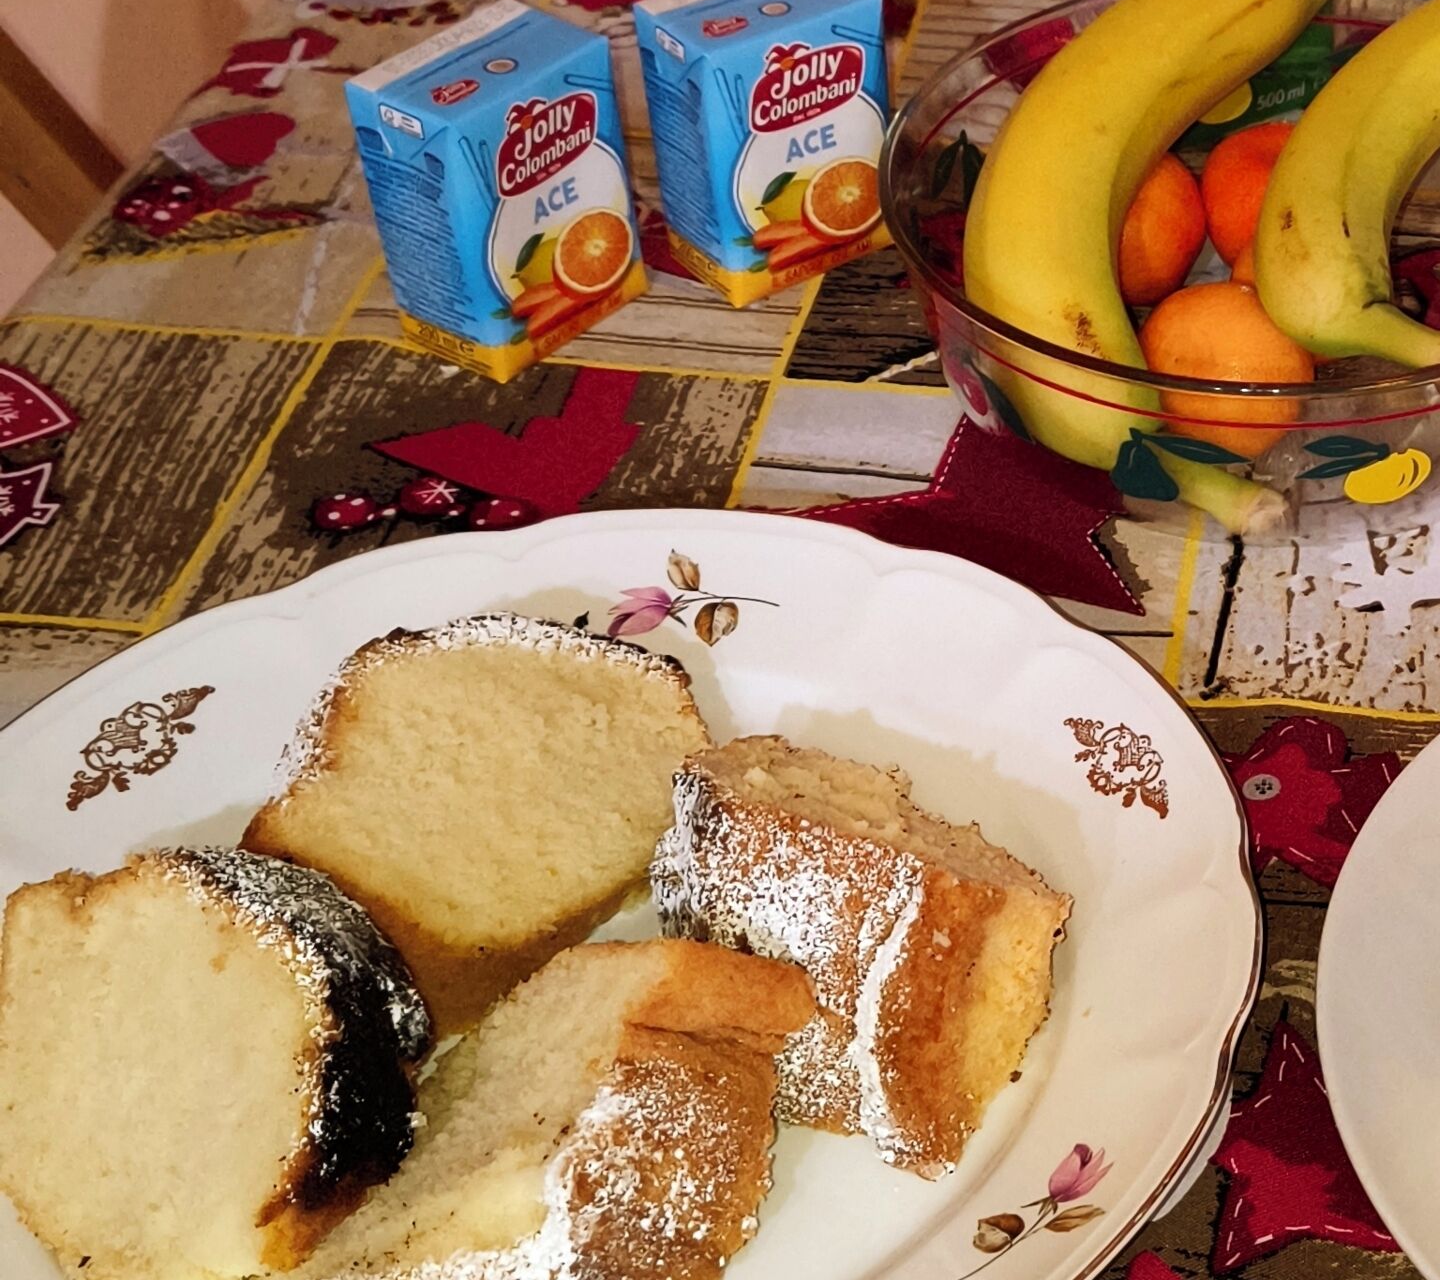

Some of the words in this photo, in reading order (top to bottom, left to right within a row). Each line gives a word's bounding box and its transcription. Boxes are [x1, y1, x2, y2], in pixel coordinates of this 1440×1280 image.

[754, 72, 857, 126] Colombani
[1256, 88, 1286, 111] 500
[1287, 80, 1306, 102] ml
[501, 120, 592, 191] Colombani
[785, 123, 838, 164] ACE
[534, 176, 580, 225] ACE
